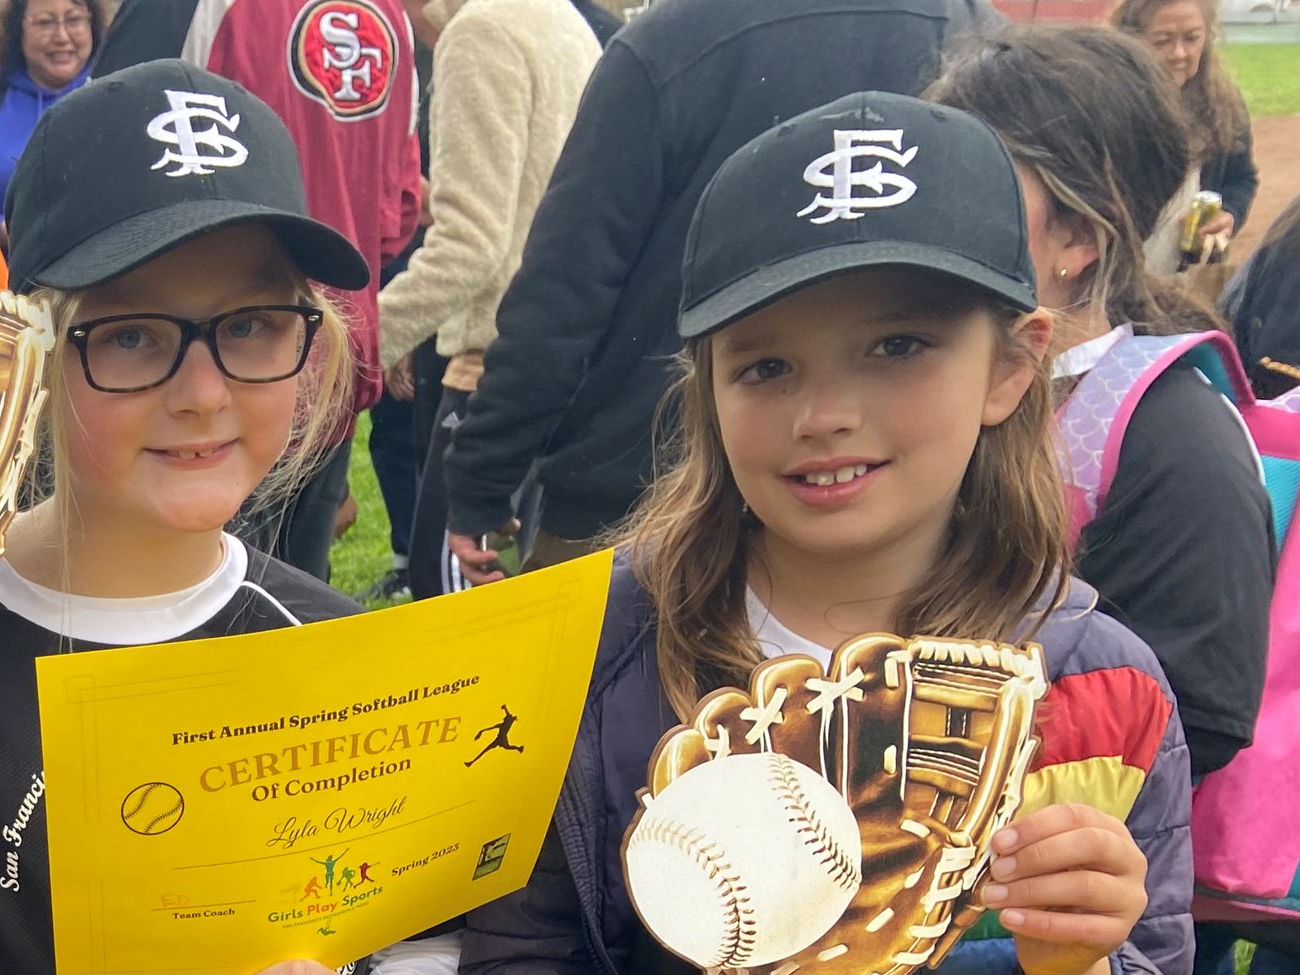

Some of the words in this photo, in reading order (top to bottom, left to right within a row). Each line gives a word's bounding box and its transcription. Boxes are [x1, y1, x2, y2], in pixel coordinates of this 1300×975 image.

[319, 12, 381, 100] SF
[172, 730, 215, 745] First
[219, 718, 285, 739] Annual
[289, 707, 349, 729] Spring
[352, 689, 418, 715] Softball
[423, 675, 479, 699] League
[200, 716, 462, 792] CERTIFICATE
[252, 783, 279, 801] Of
[285, 759, 411, 796] Completion
[267, 817, 318, 848] Lyla
[325, 796, 407, 833] Wright
[0, 851, 19, 892] San
[391, 855, 429, 876] Spring
[173, 910, 201, 919] Team
[204, 908, 235, 917] Coach
[268, 908, 304, 922] Girls
[307, 902, 338, 916] Play
[342, 885, 384, 906] Sports
